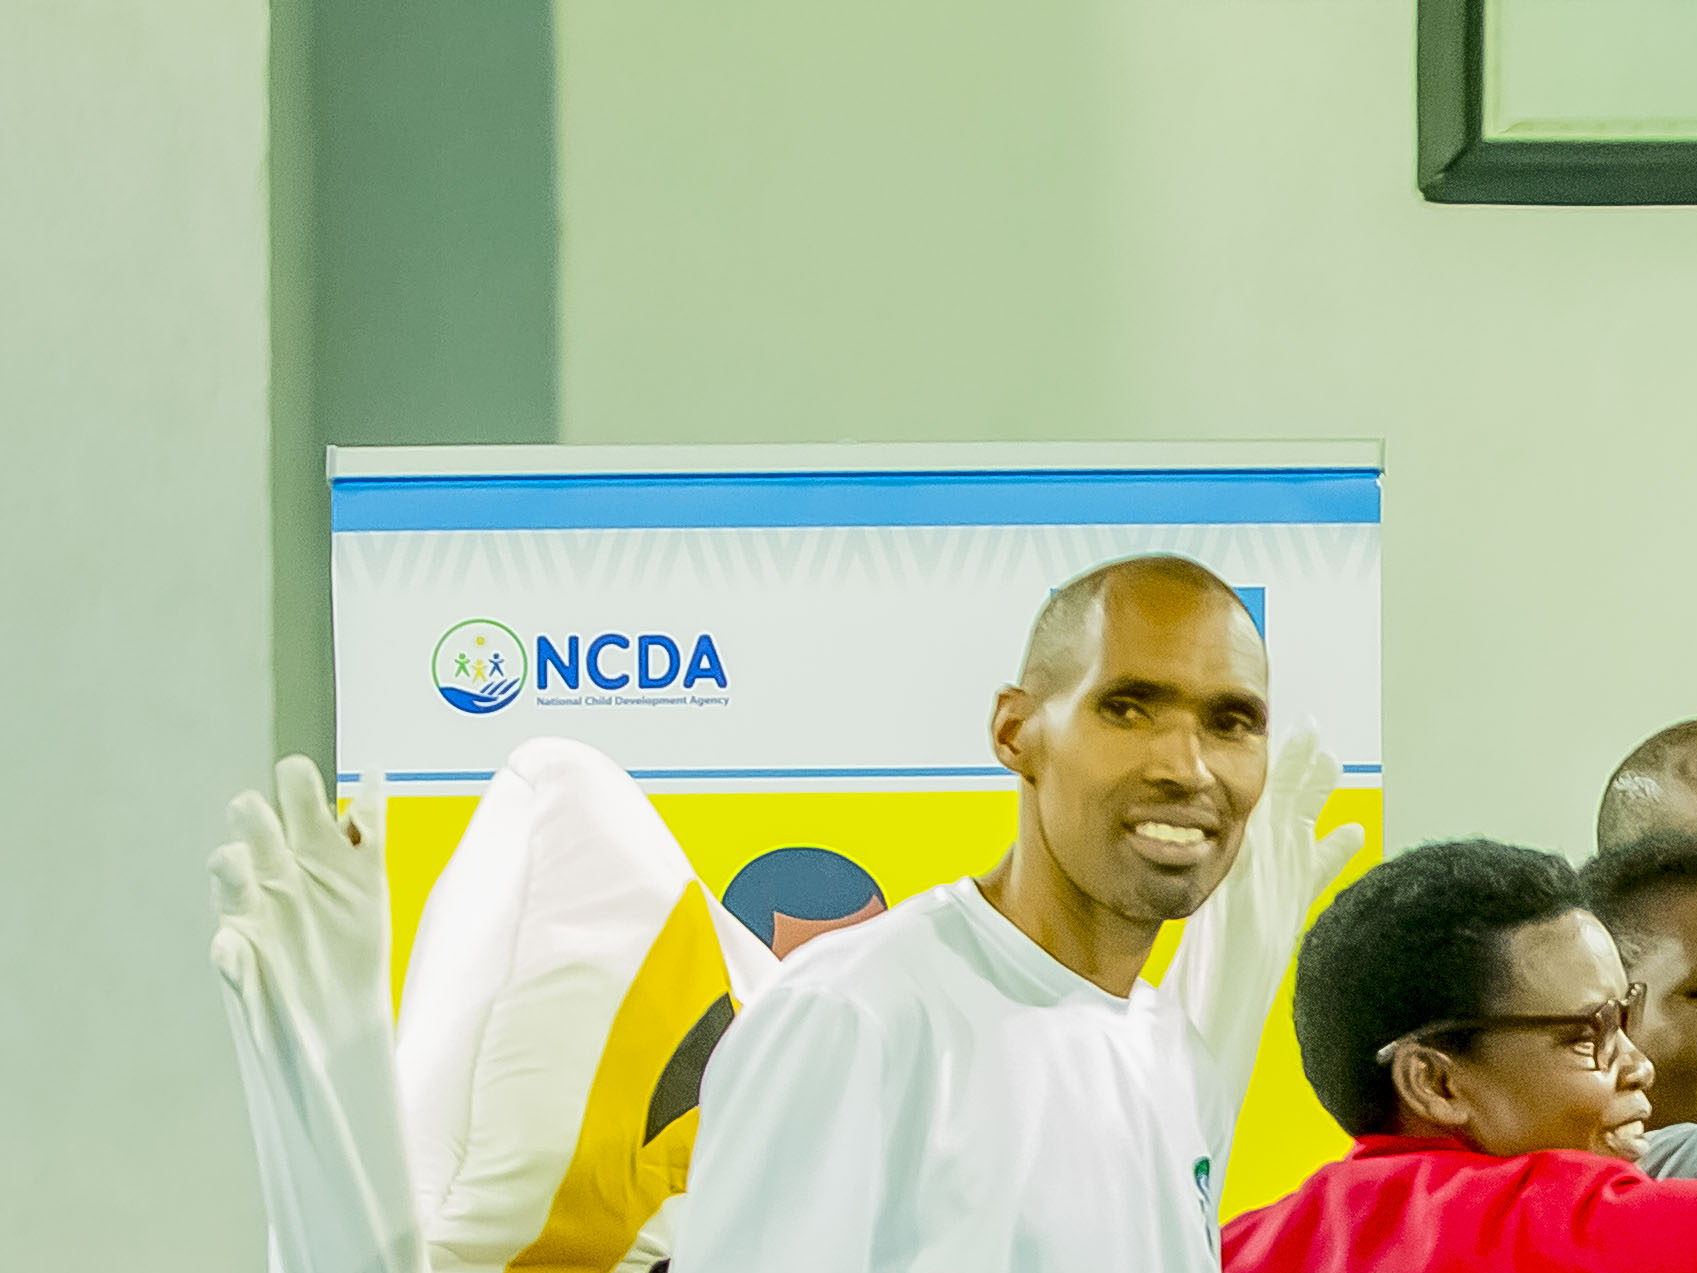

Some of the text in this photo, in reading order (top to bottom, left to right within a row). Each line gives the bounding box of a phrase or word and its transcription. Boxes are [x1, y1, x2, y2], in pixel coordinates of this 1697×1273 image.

[537, 633, 728, 690] NCDA
[536, 695, 730, 708] National Child Development Agency
